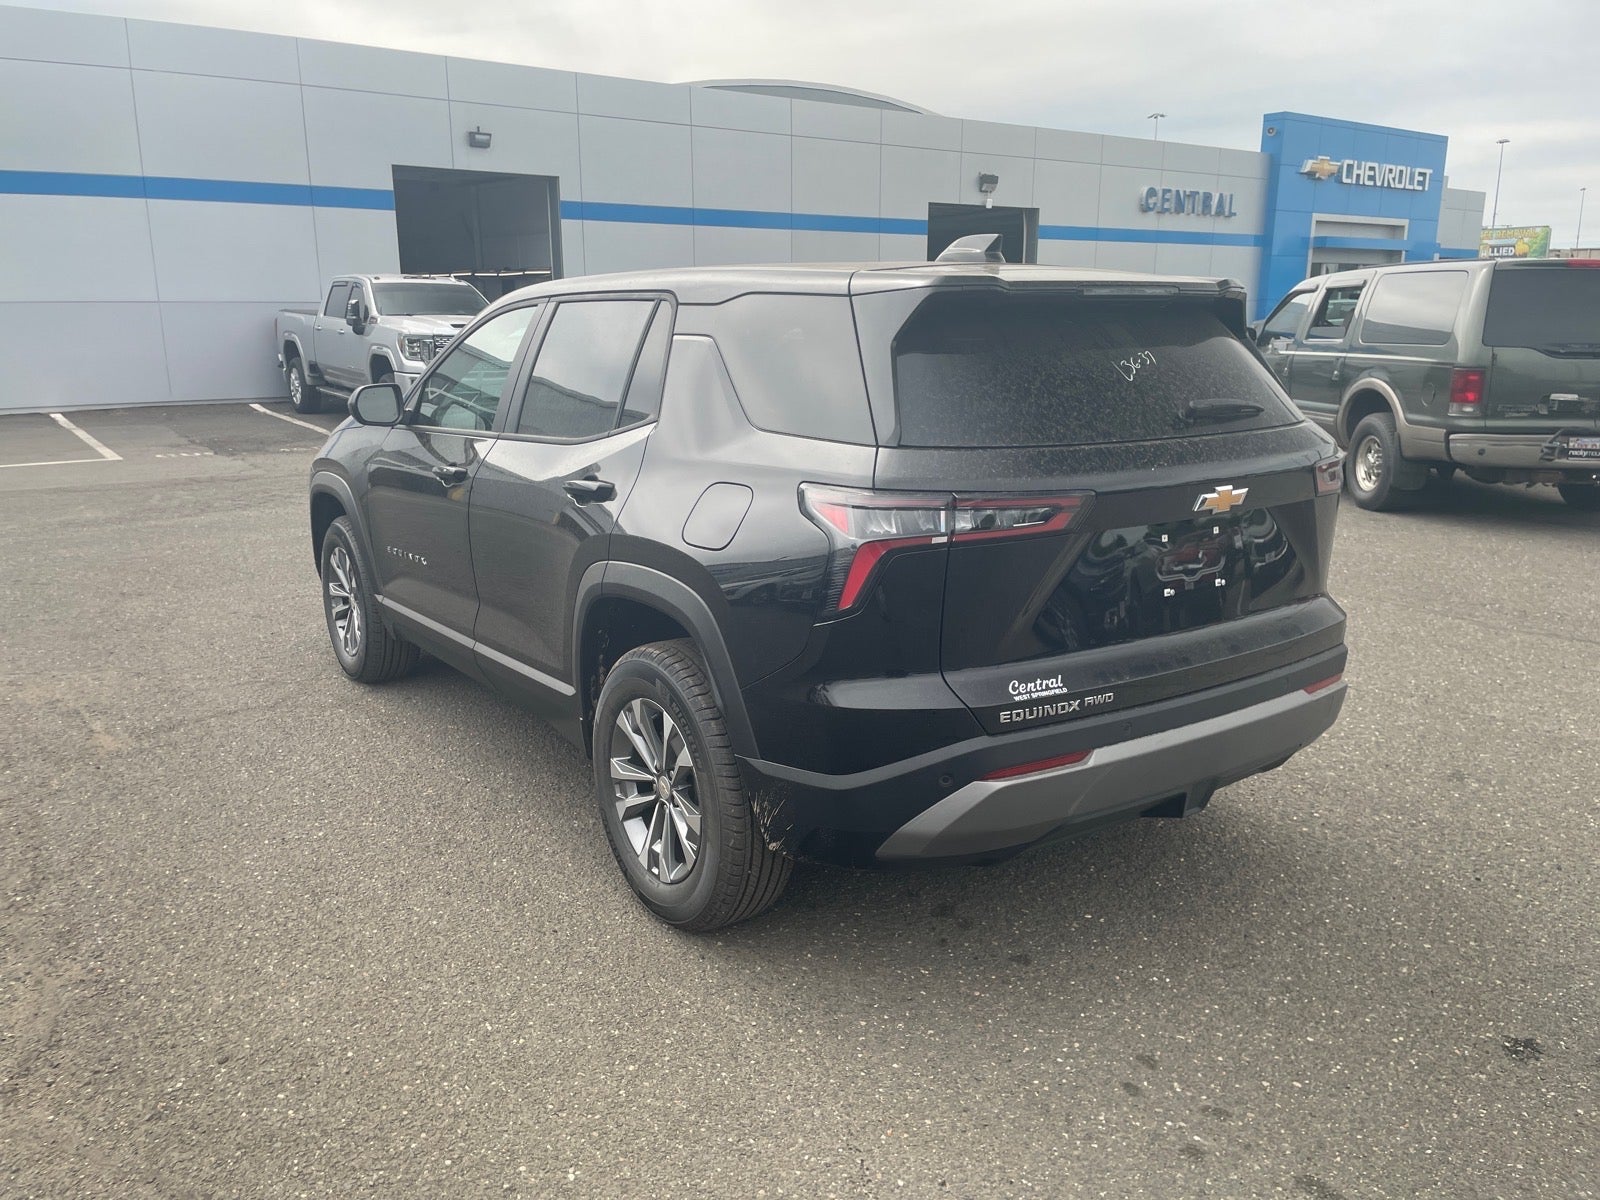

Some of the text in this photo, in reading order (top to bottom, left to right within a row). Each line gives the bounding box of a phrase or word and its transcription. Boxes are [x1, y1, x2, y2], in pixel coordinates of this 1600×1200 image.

[1341, 159, 1433, 191] CHEVROLET
[1141, 186, 1237, 217] CENTRAL
[1009, 674, 1063, 694] Central
[1031, 687, 1068, 698] SPRINGFIELD
[1000, 692, 1114, 723] EQUINOX AWD
